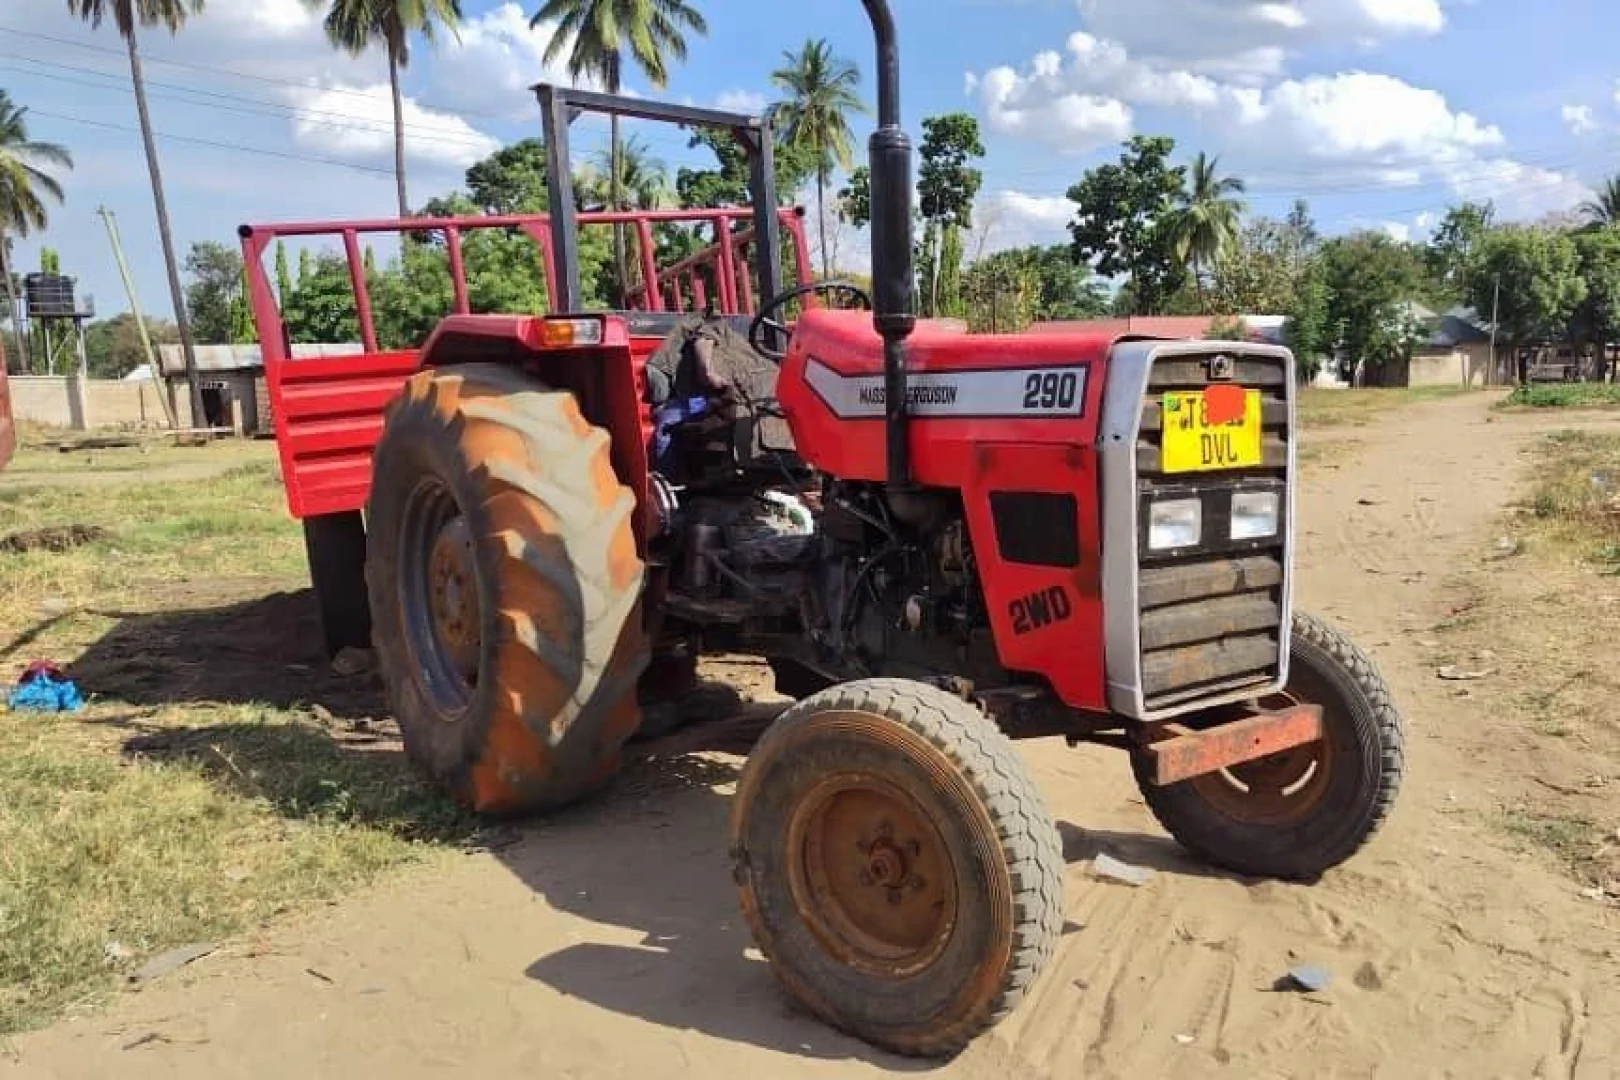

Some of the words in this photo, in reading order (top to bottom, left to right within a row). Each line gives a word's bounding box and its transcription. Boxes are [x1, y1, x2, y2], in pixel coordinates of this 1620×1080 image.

[859, 385, 886, 405] MASS
[1023, 372, 1077, 409] 290
[1200, 433, 1238, 464] DVL
[1008, 585, 1071, 634] 2WD
